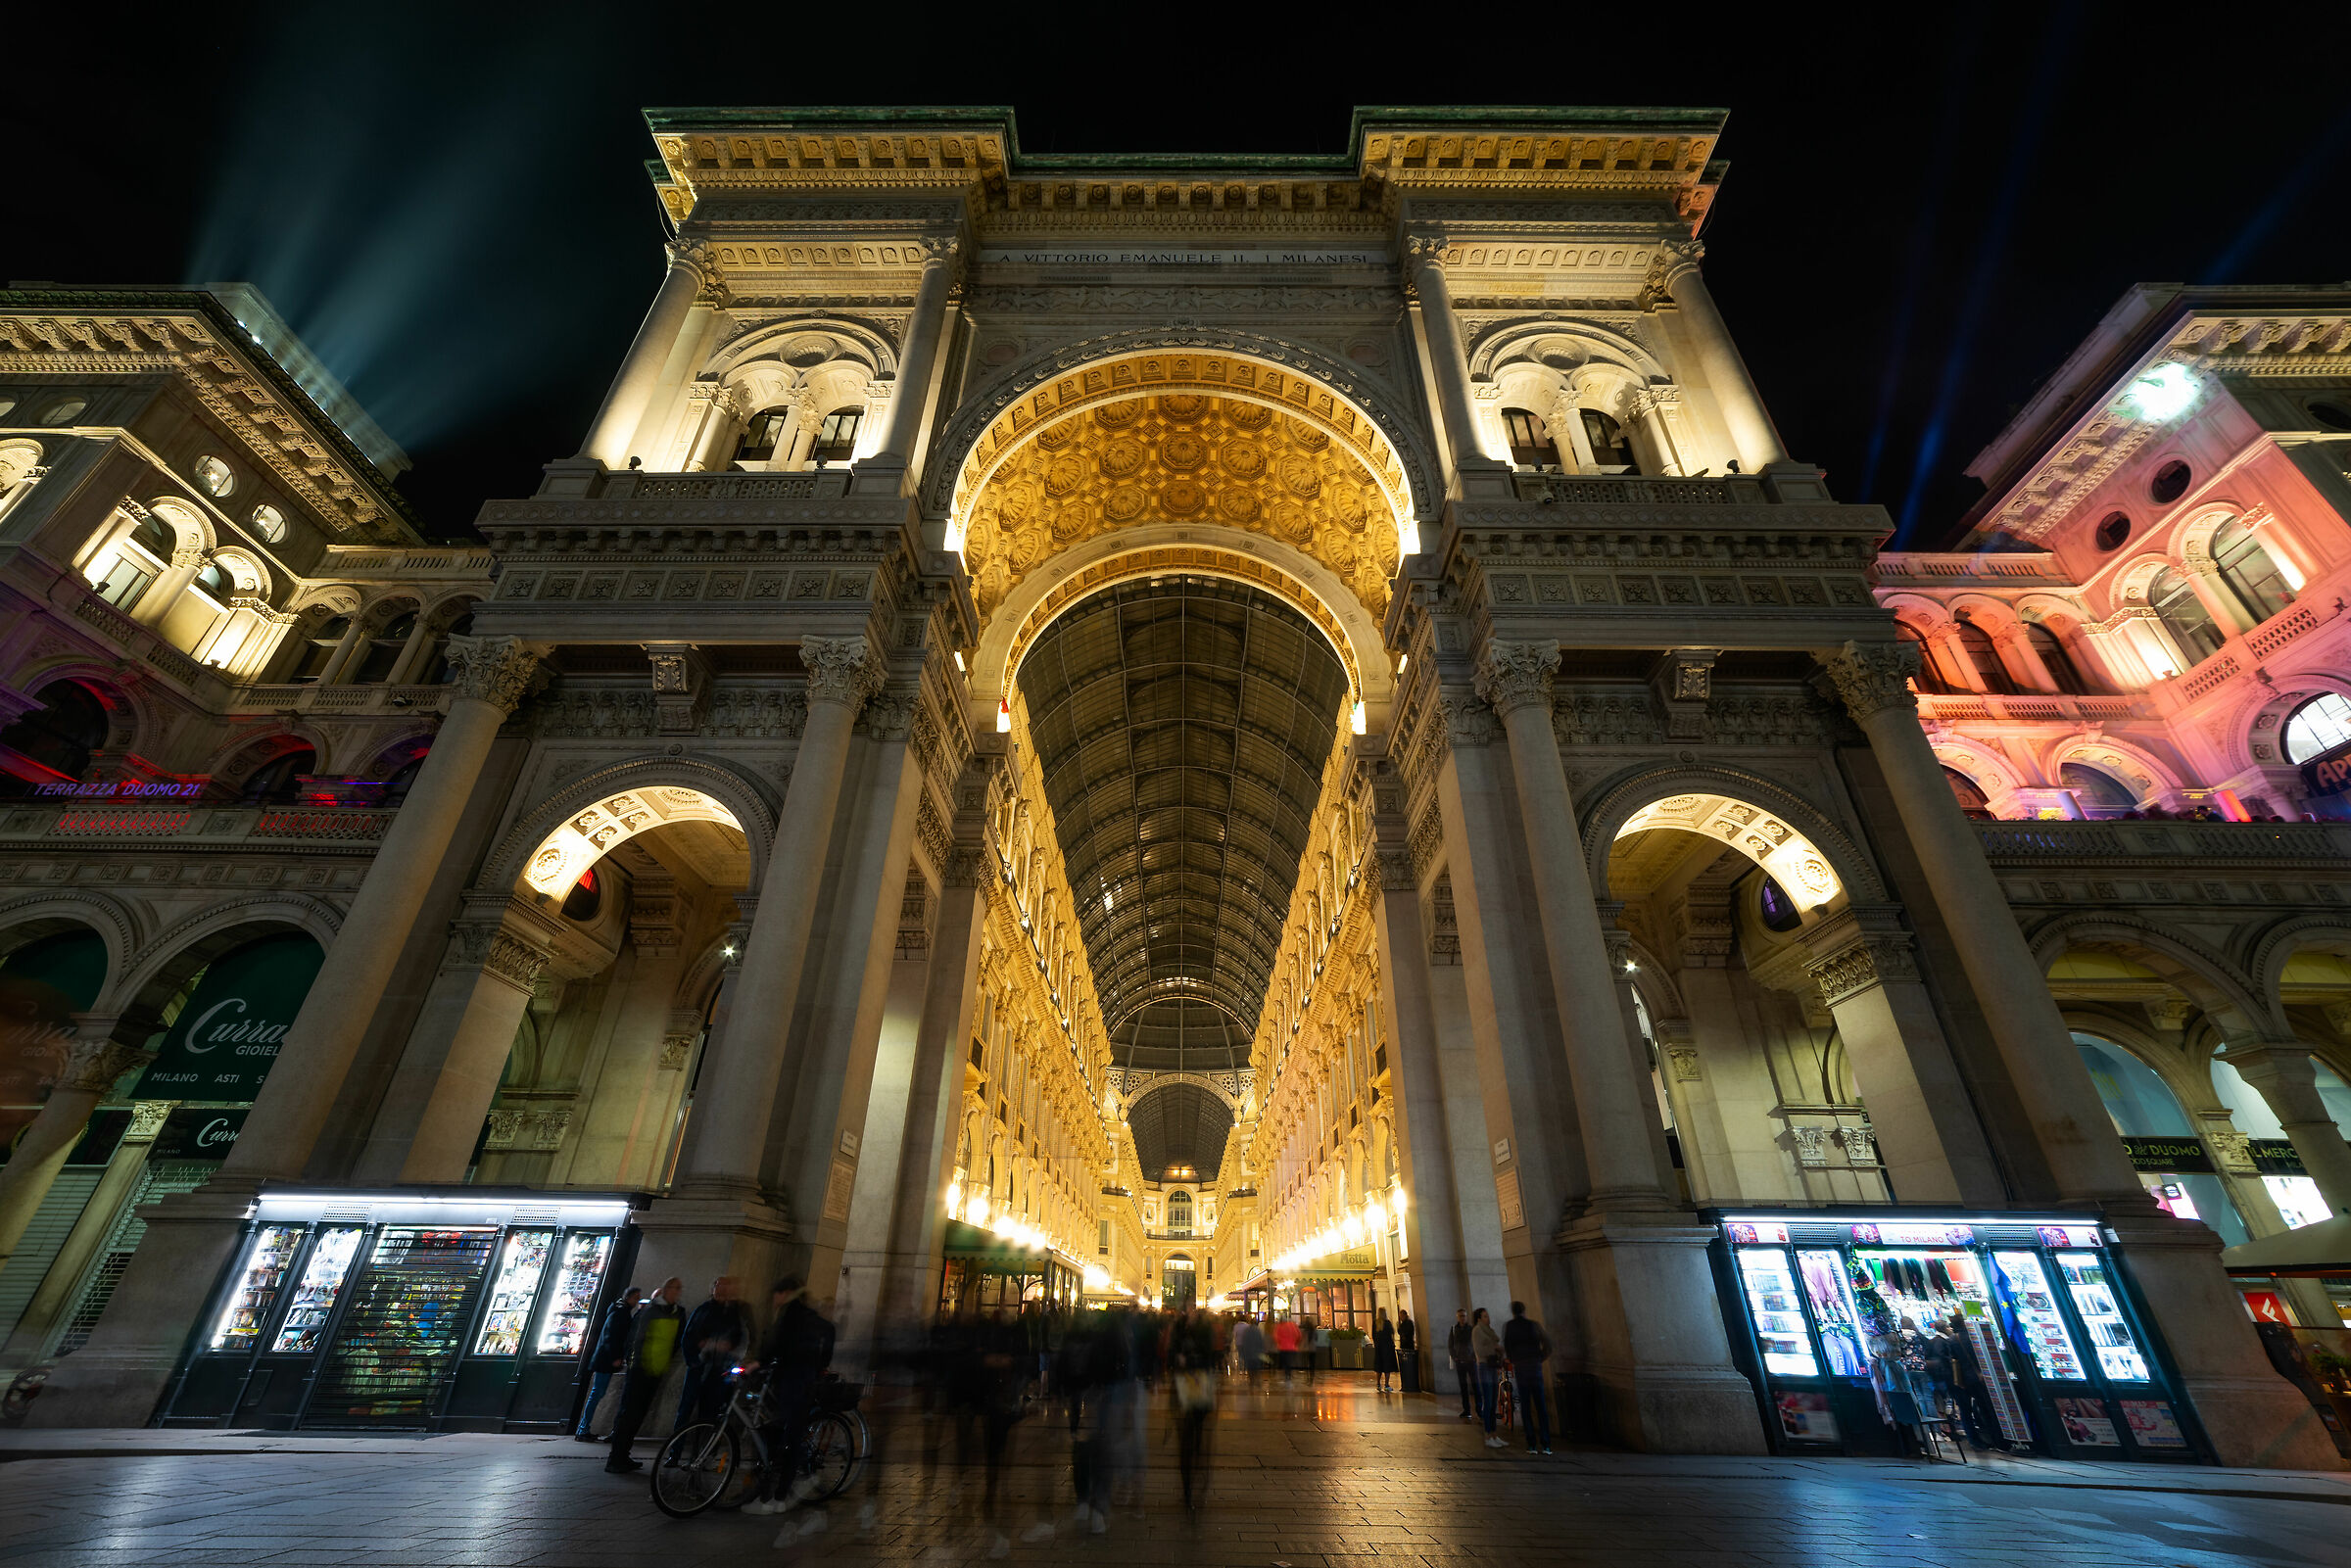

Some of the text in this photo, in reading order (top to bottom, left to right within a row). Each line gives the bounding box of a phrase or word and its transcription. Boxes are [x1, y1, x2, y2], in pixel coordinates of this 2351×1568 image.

[33, 784, 201, 796] TERRAZZA DUOMO 21
[150, 1072, 199, 1082] MILANO
[214, 1073, 241, 1083] ASTI
[2148, 1144, 2201, 1157] DUOMO
[1899, 1235, 1911, 1244] TO
[1340, 1253, 1369, 1264] Motta
